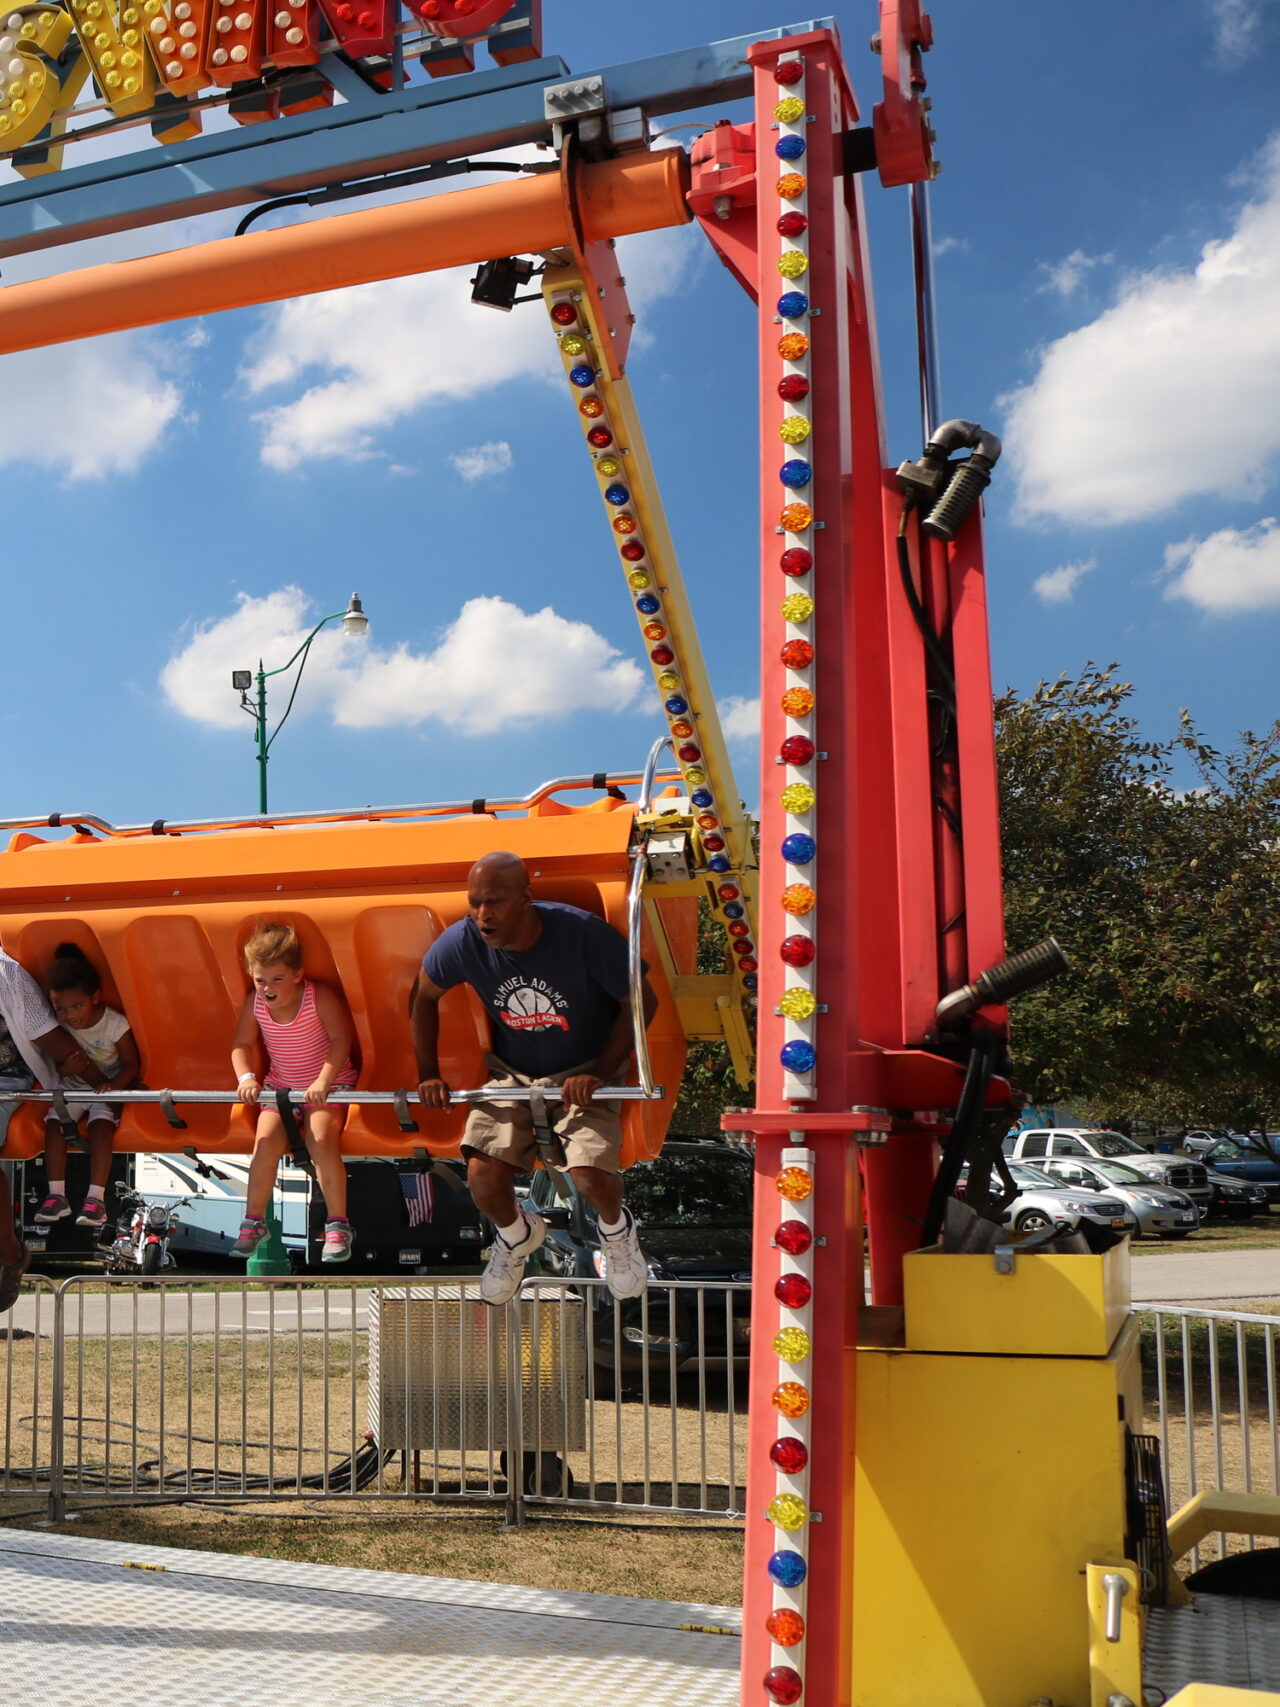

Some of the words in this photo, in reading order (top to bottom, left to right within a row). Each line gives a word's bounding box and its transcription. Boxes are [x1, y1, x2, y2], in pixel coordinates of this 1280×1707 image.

[493, 975, 528, 1007] SAMUEL
[530, 977, 567, 1008] ADAMS
[506, 1016, 536, 1027] BOSTON
[537, 1015, 562, 1024] LAGER
